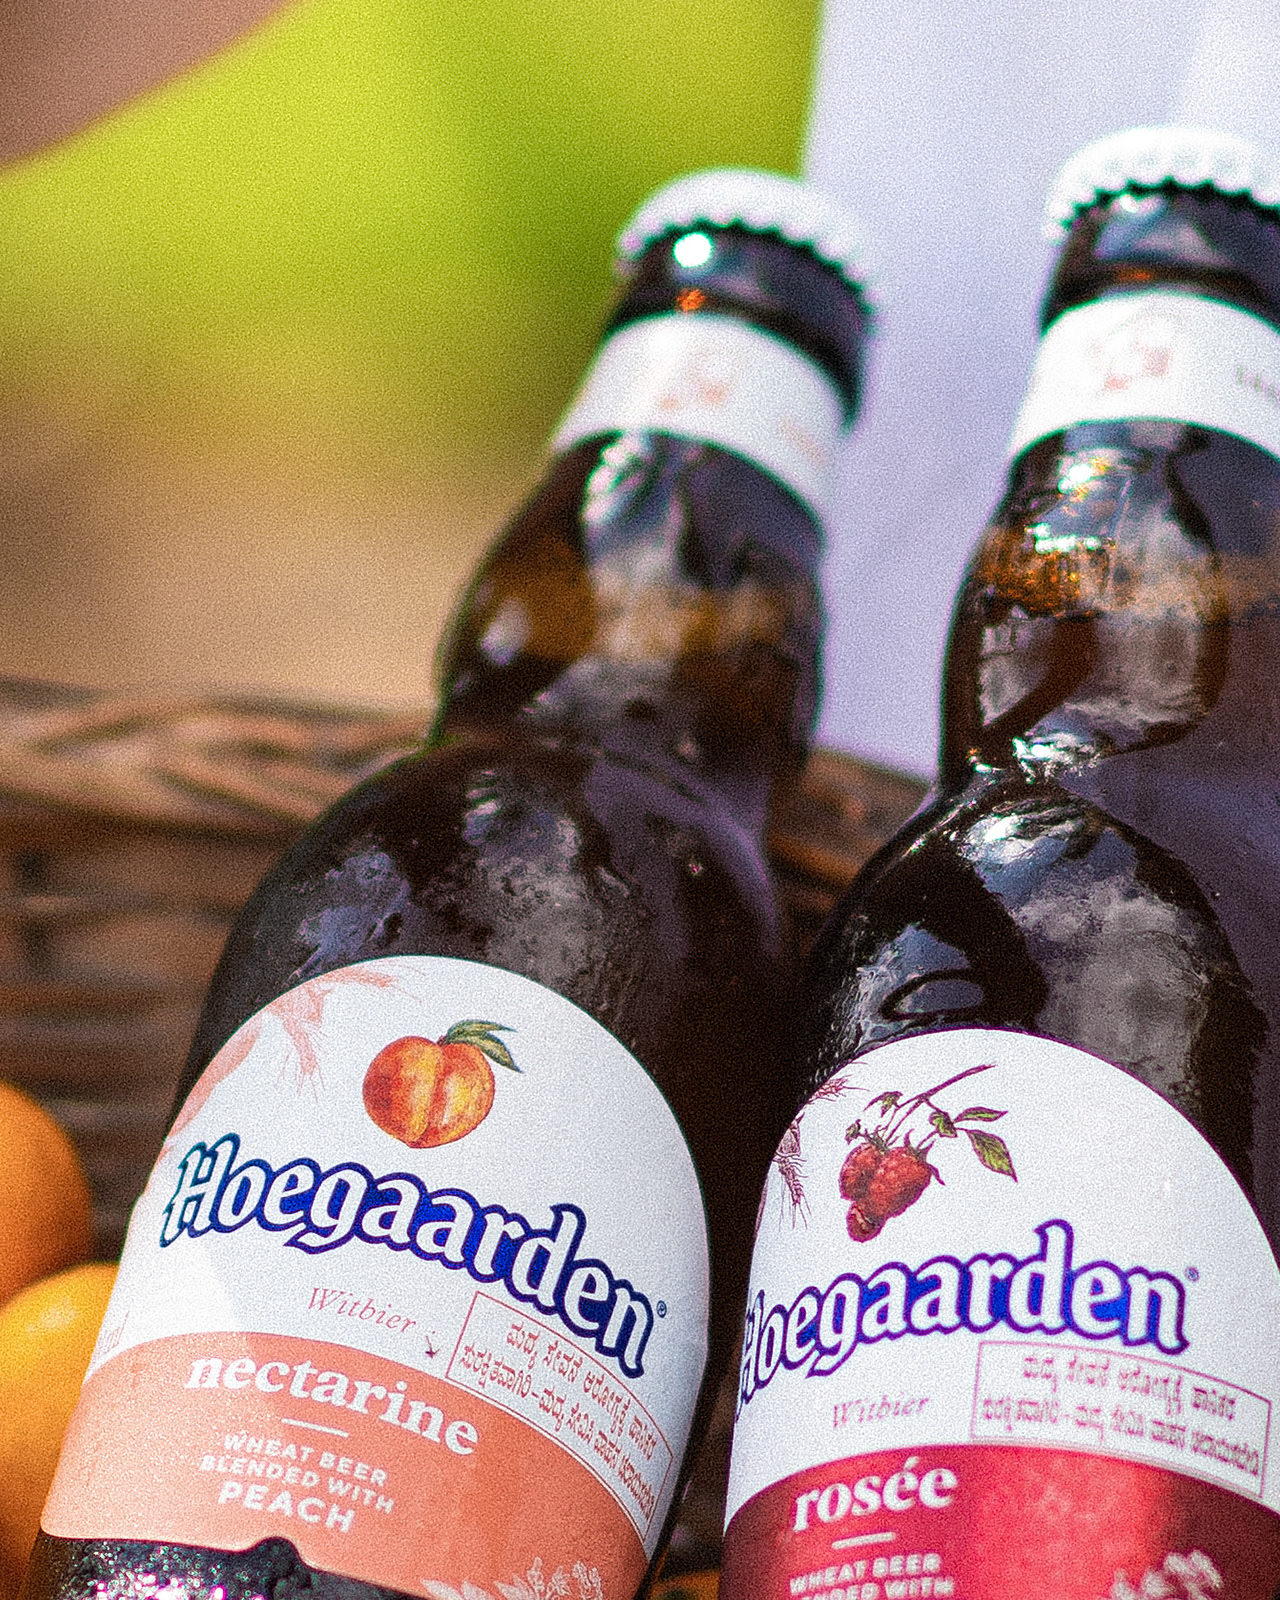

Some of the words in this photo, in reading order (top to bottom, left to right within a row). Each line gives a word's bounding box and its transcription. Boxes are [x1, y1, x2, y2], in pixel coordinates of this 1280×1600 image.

[158, 1133, 655, 1379] Hoegaarden
[308, 1287, 417, 1336] Witbier
[184, 1357, 479, 1455] nectarine
[199, 1454, 320, 1488] BLENDED
[327, 1479, 394, 1515] WITH
[224, 1432, 315, 1462] WHEAT
[320, 1452, 388, 1487] BEER
[217, 1481, 356, 1532] PEACH
[792, 1456, 959, 1532] rosée
[789, 1559, 867, 1595] WHEAT
[871, 1552, 942, 1579] BEER
[884, 1576, 955, 1600] WITH
